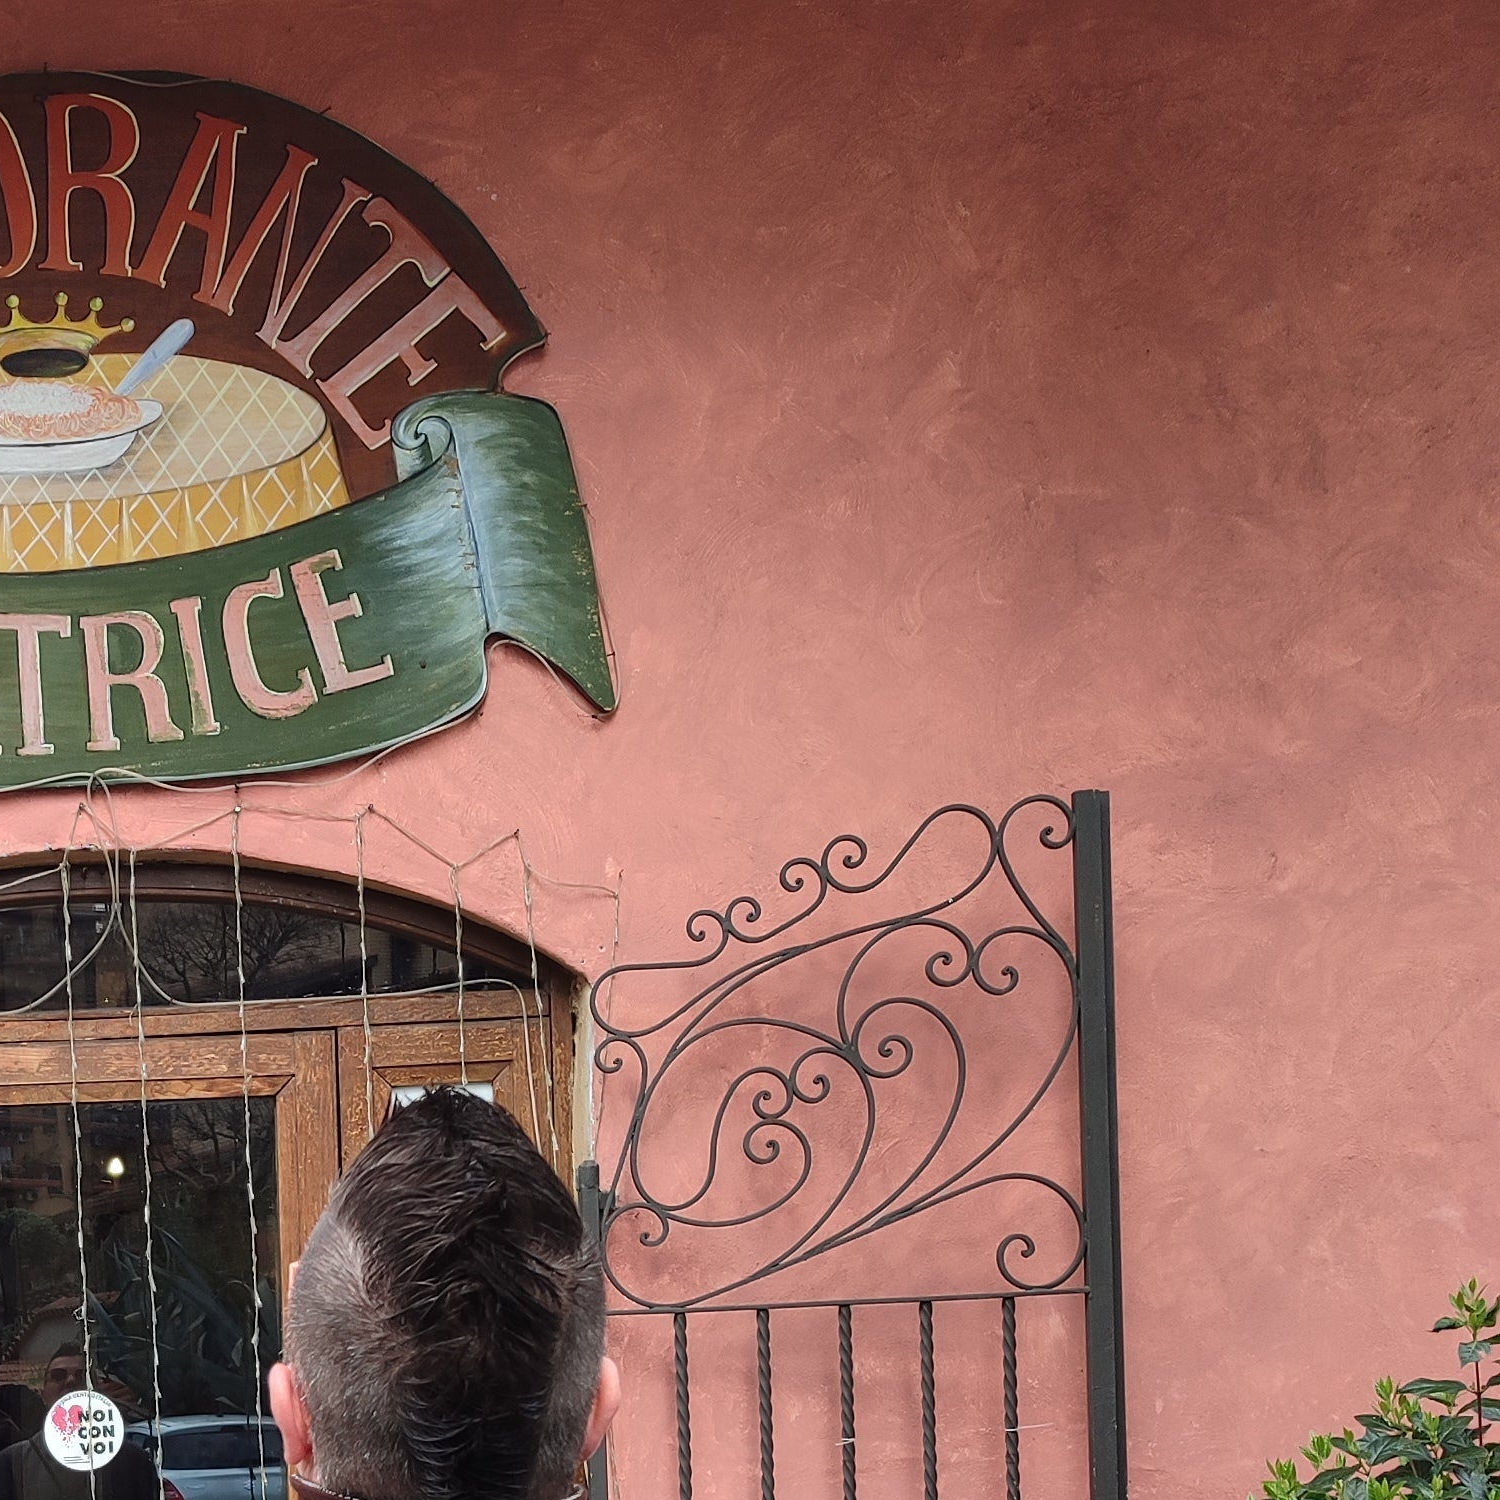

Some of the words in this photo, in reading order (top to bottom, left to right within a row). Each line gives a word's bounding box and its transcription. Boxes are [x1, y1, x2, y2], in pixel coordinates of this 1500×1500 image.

[78, 1409, 114, 1424] NOI
[78, 1425, 115, 1440] CON
[79, 1441, 114, 1455] VOI
